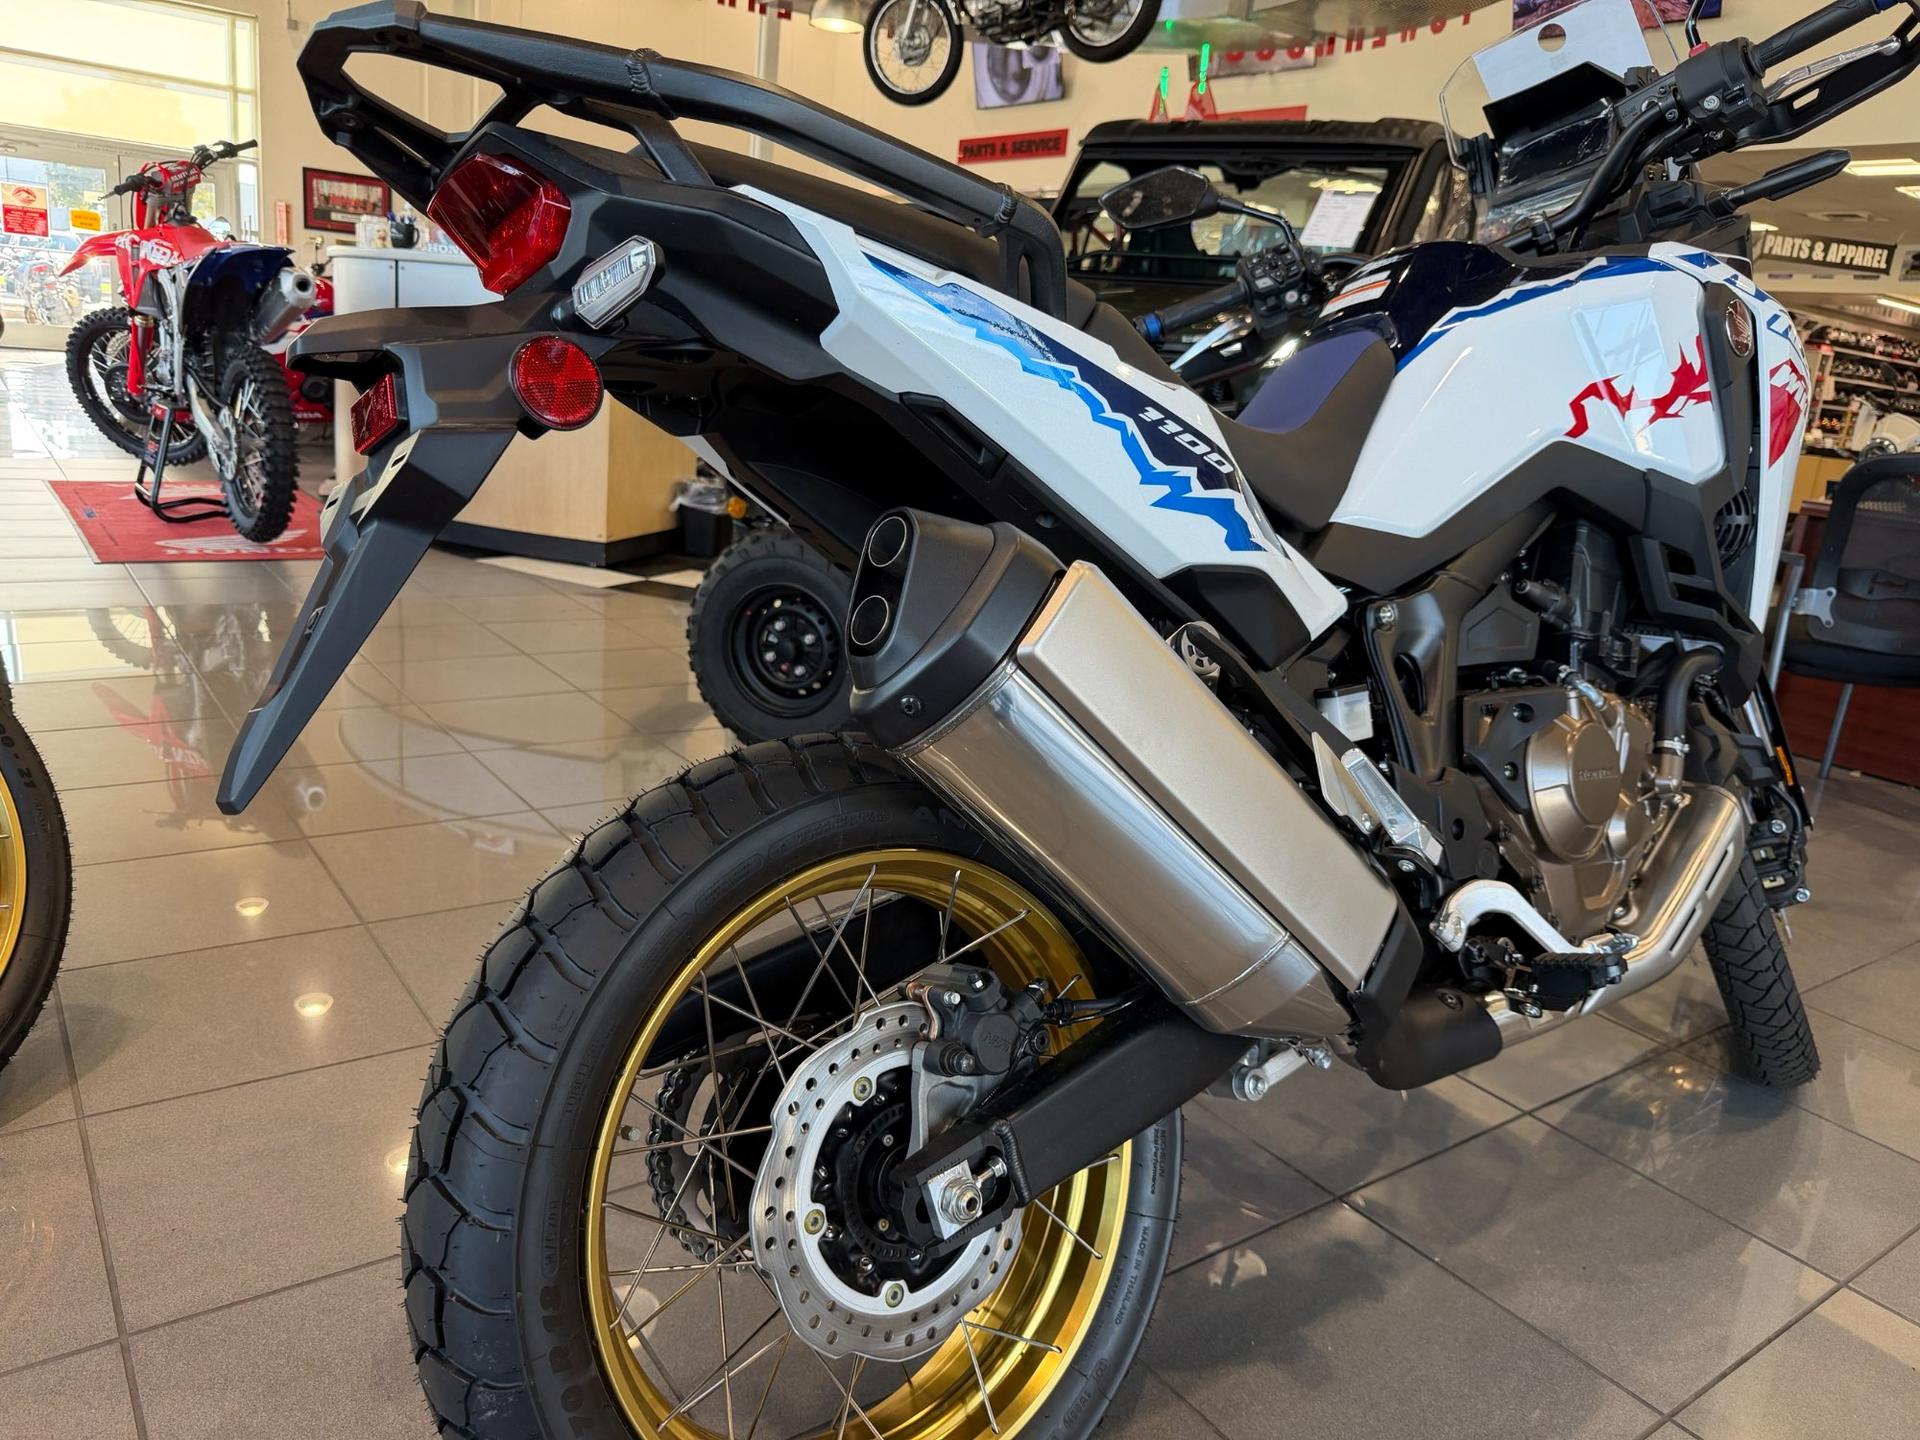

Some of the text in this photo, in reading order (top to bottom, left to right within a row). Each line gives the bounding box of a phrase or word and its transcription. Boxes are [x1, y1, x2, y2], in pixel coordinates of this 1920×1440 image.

[963, 142, 996, 157] PARTS
[1012, 136, 1061, 153] SERVICE
[1763, 234, 1889, 269] PARTS & APPAREL
[1138, 406, 1234, 474] 1100
[1137, 1225, 1151, 1258] MADE
[1133, 1259, 1143, 1271] IN
[1114, 1274, 1139, 1327] THAILAND
